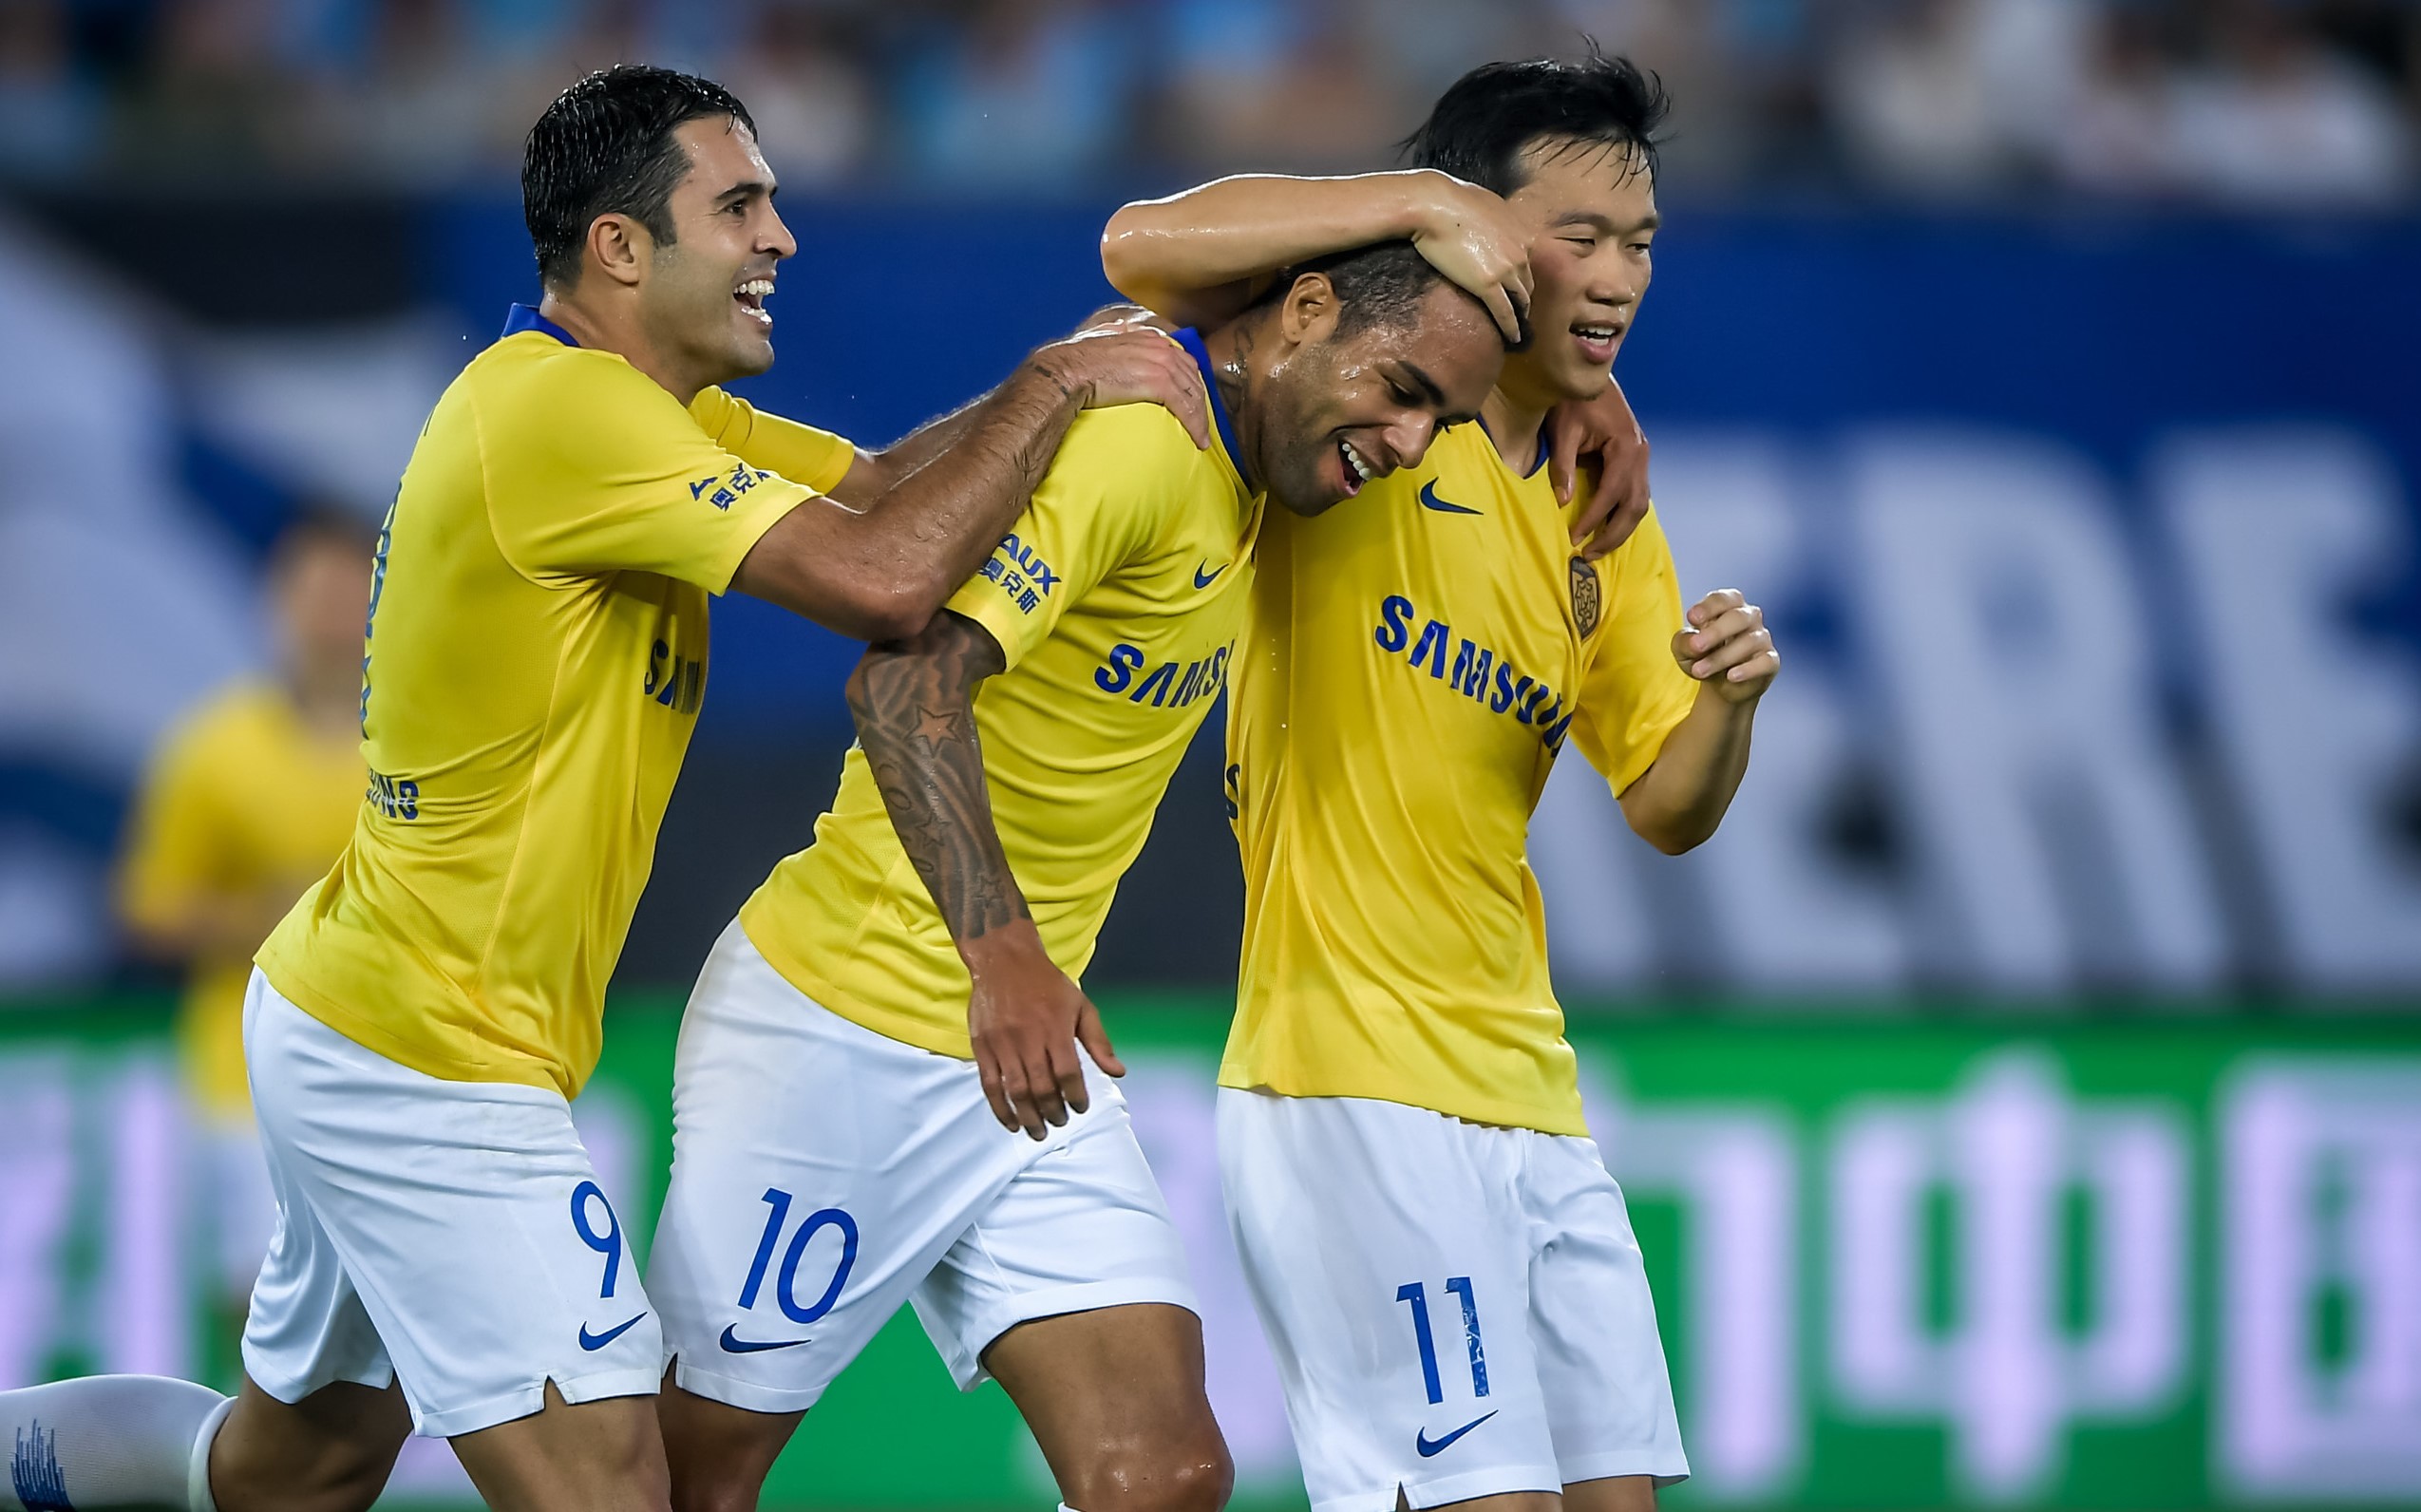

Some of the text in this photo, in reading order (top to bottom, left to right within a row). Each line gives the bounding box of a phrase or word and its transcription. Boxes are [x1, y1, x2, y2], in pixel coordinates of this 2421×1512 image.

[998, 533, 1062, 597] AUX
[1094, 637, 1235, 708] SAMS
[1374, 595, 1573, 759] SAMSUN
[570, 1181, 621, 1299] 9
[737, 1187, 860, 1324] 10
[1395, 1276, 1490, 1405] 11
